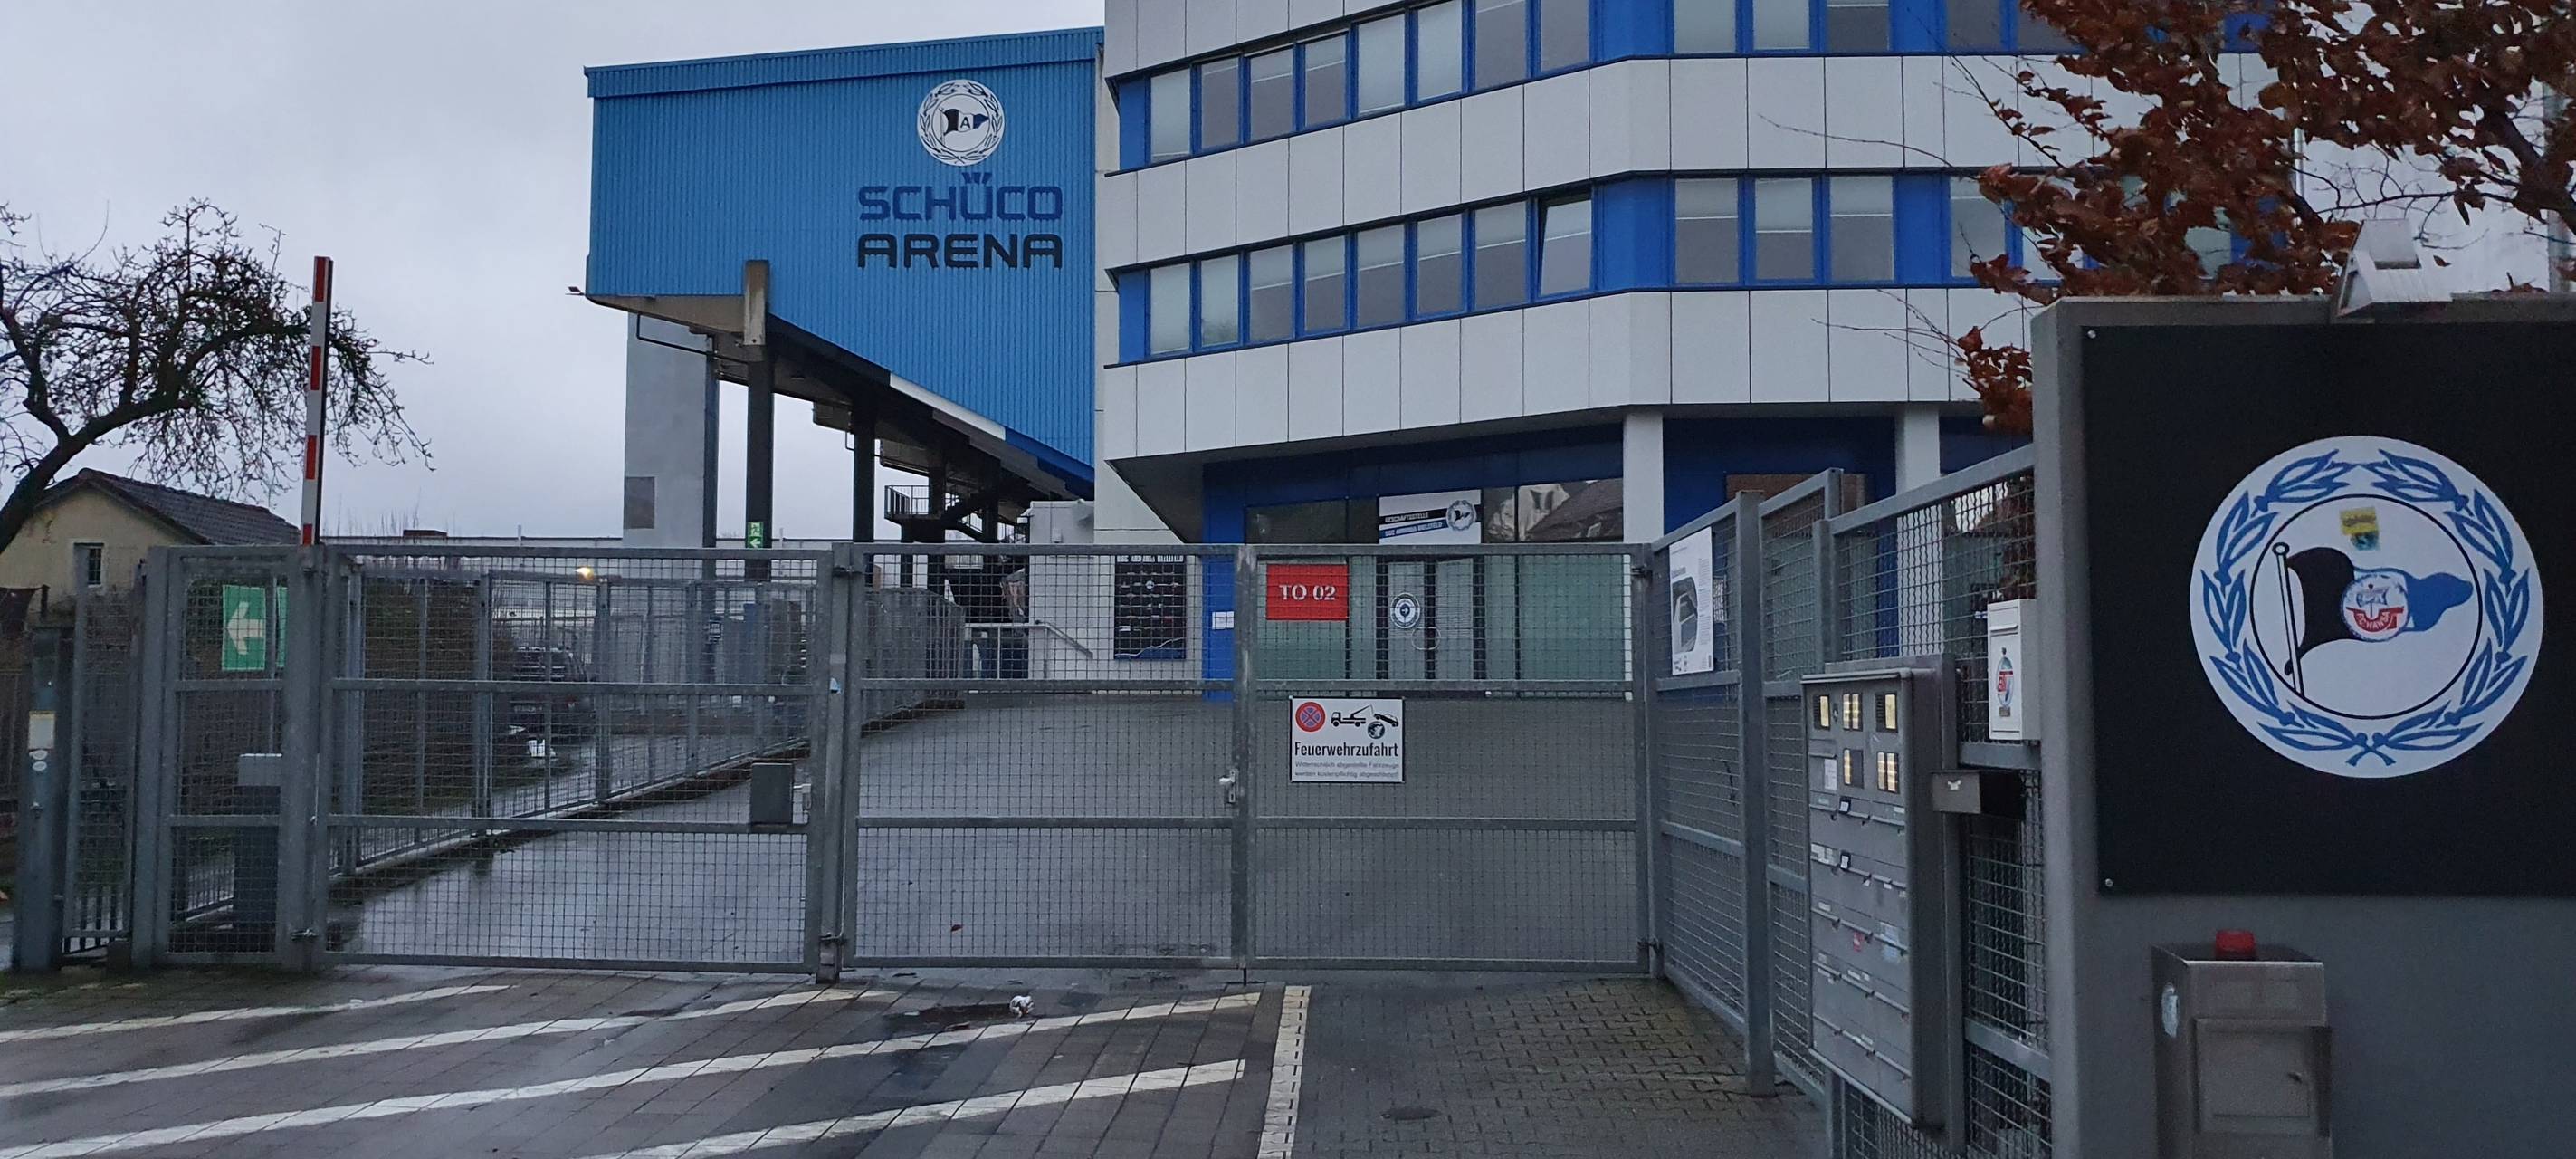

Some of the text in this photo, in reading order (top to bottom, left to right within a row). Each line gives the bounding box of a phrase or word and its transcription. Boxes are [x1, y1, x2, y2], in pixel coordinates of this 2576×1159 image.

[960, 116, 971, 129] A
[858, 172, 1063, 221] SCHÜCO
[857, 234, 1063, 269] ARENA
[1279, 584, 1336, 600] TO 02
[1294, 742, 1398, 757] Feuerwehrzufahrt
